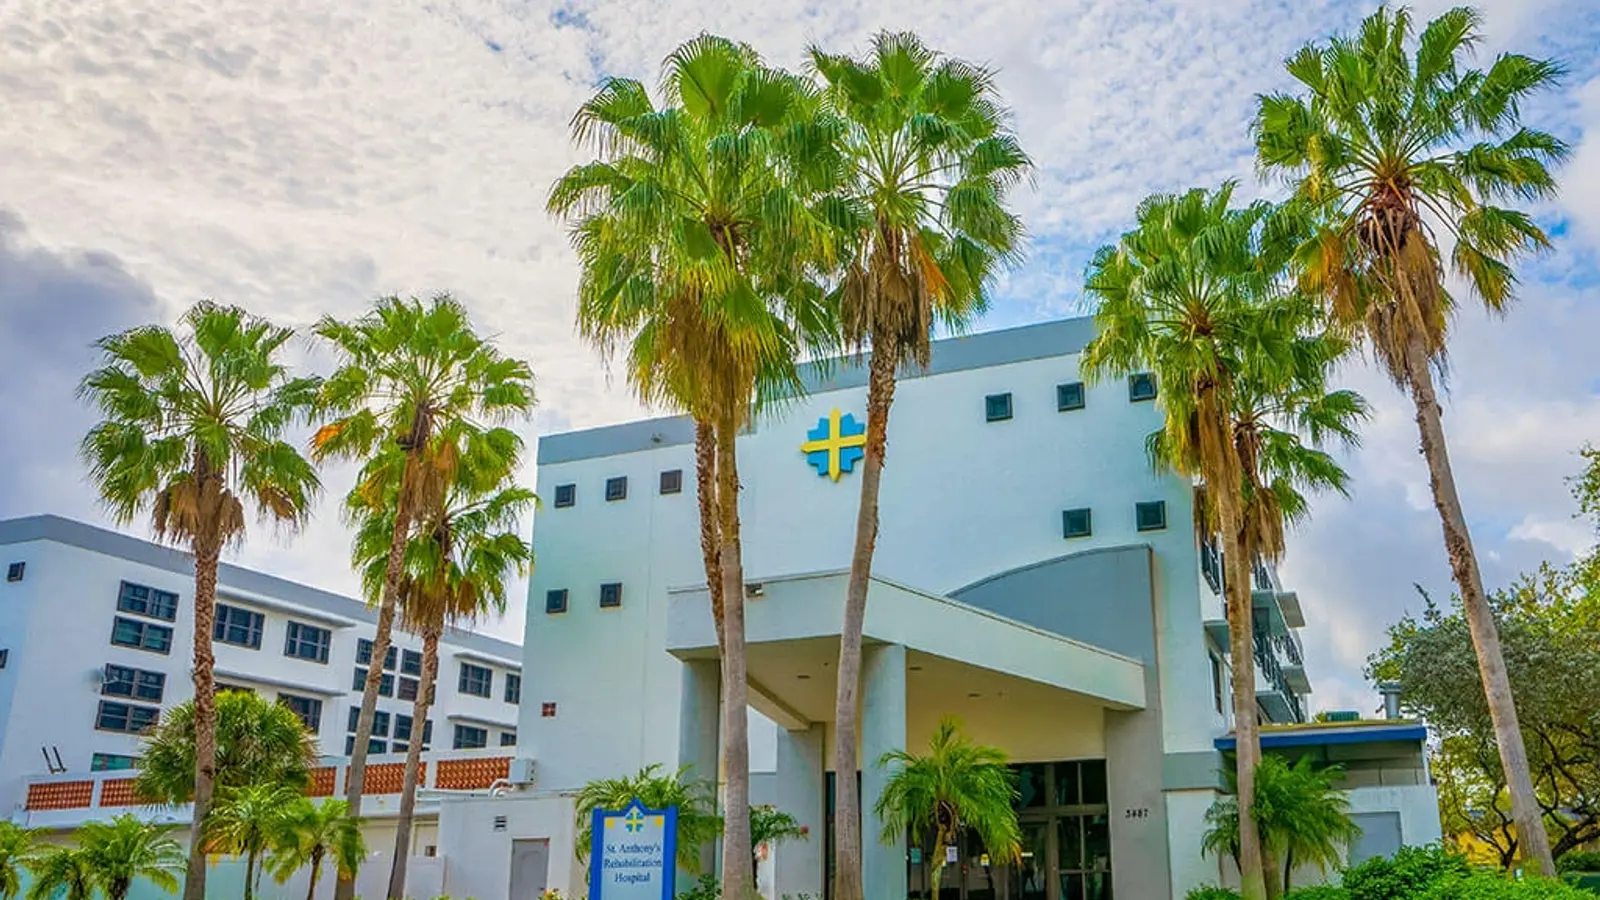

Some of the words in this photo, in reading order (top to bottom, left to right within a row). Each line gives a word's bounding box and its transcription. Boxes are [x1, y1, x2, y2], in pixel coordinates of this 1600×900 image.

[619, 843, 661, 855] Anthony's
[604, 858, 662, 868] Rehabilitation
[614, 872, 651, 884] Hospital
